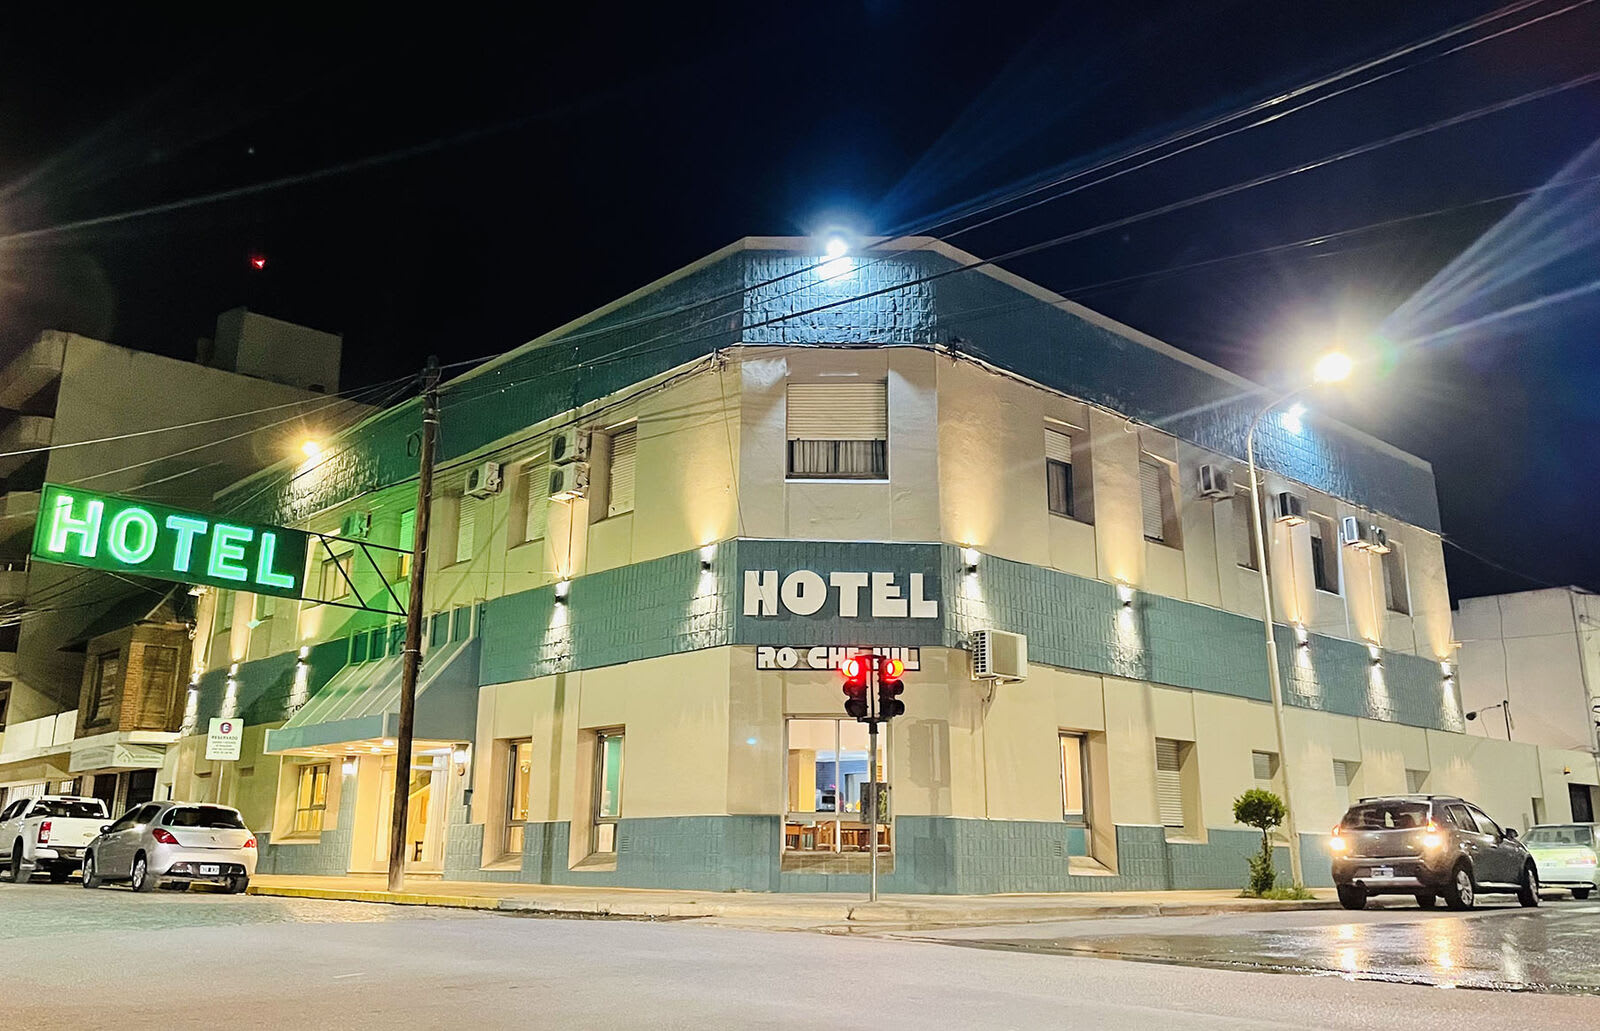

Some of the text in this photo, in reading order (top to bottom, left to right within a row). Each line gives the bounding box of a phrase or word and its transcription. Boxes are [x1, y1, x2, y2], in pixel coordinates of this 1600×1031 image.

[48, 494, 295, 589] HOTEL
[743, 569, 939, 618] HOTEL
[757, 646, 799, 669] RO
